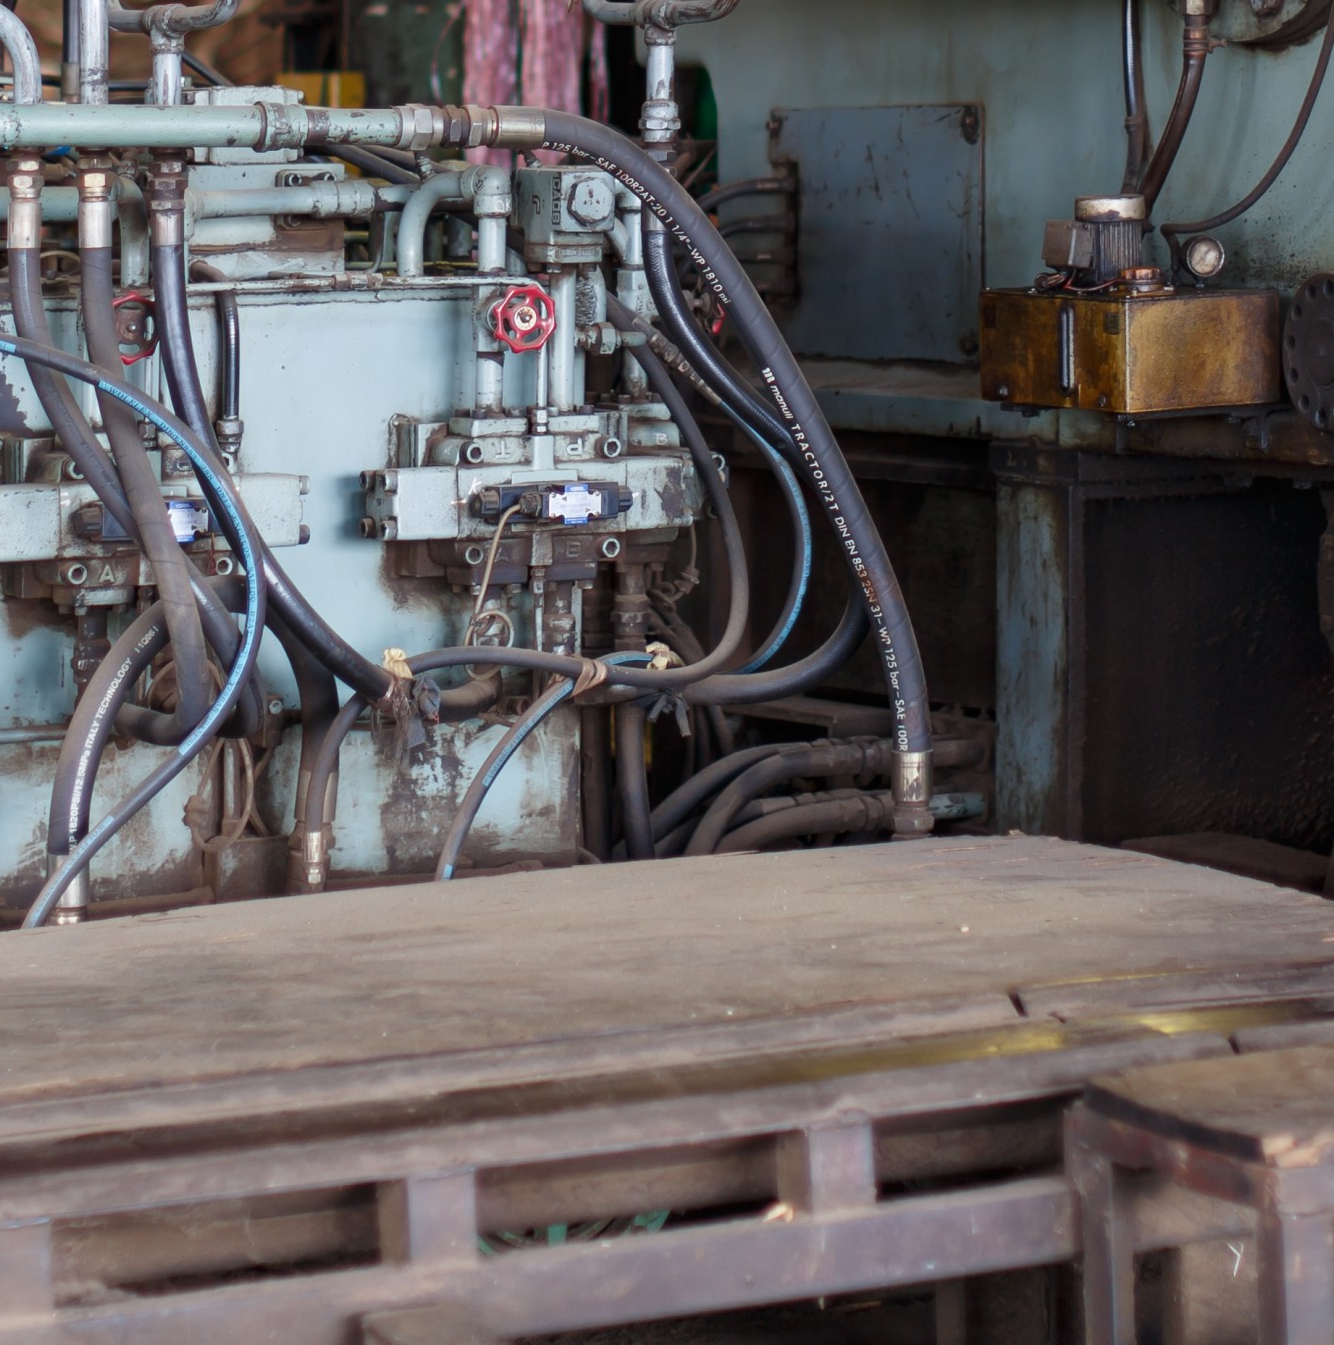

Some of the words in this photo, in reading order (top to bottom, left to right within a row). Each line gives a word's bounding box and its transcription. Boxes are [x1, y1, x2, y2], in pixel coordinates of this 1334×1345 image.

[552, 142, 570, 152] 125
[702, 266, 723, 293] 1810
[718, 292, 732, 305] psi
[770, 385, 794, 419] manuli
[835, 516, 850, 537] DIN
[845, 540, 859, 555] EN
[99, 564, 115, 583] A
[852, 557, 866, 577] 853
[247, 566, 256, 603] SAE100
[878, 626, 891, 645] WP
[884, 648, 897, 668] 125
[84, 720, 100, 751] ITALY
[95, 657, 133, 720] TECHNOLOGY
[897, 724, 908, 751] 100R
